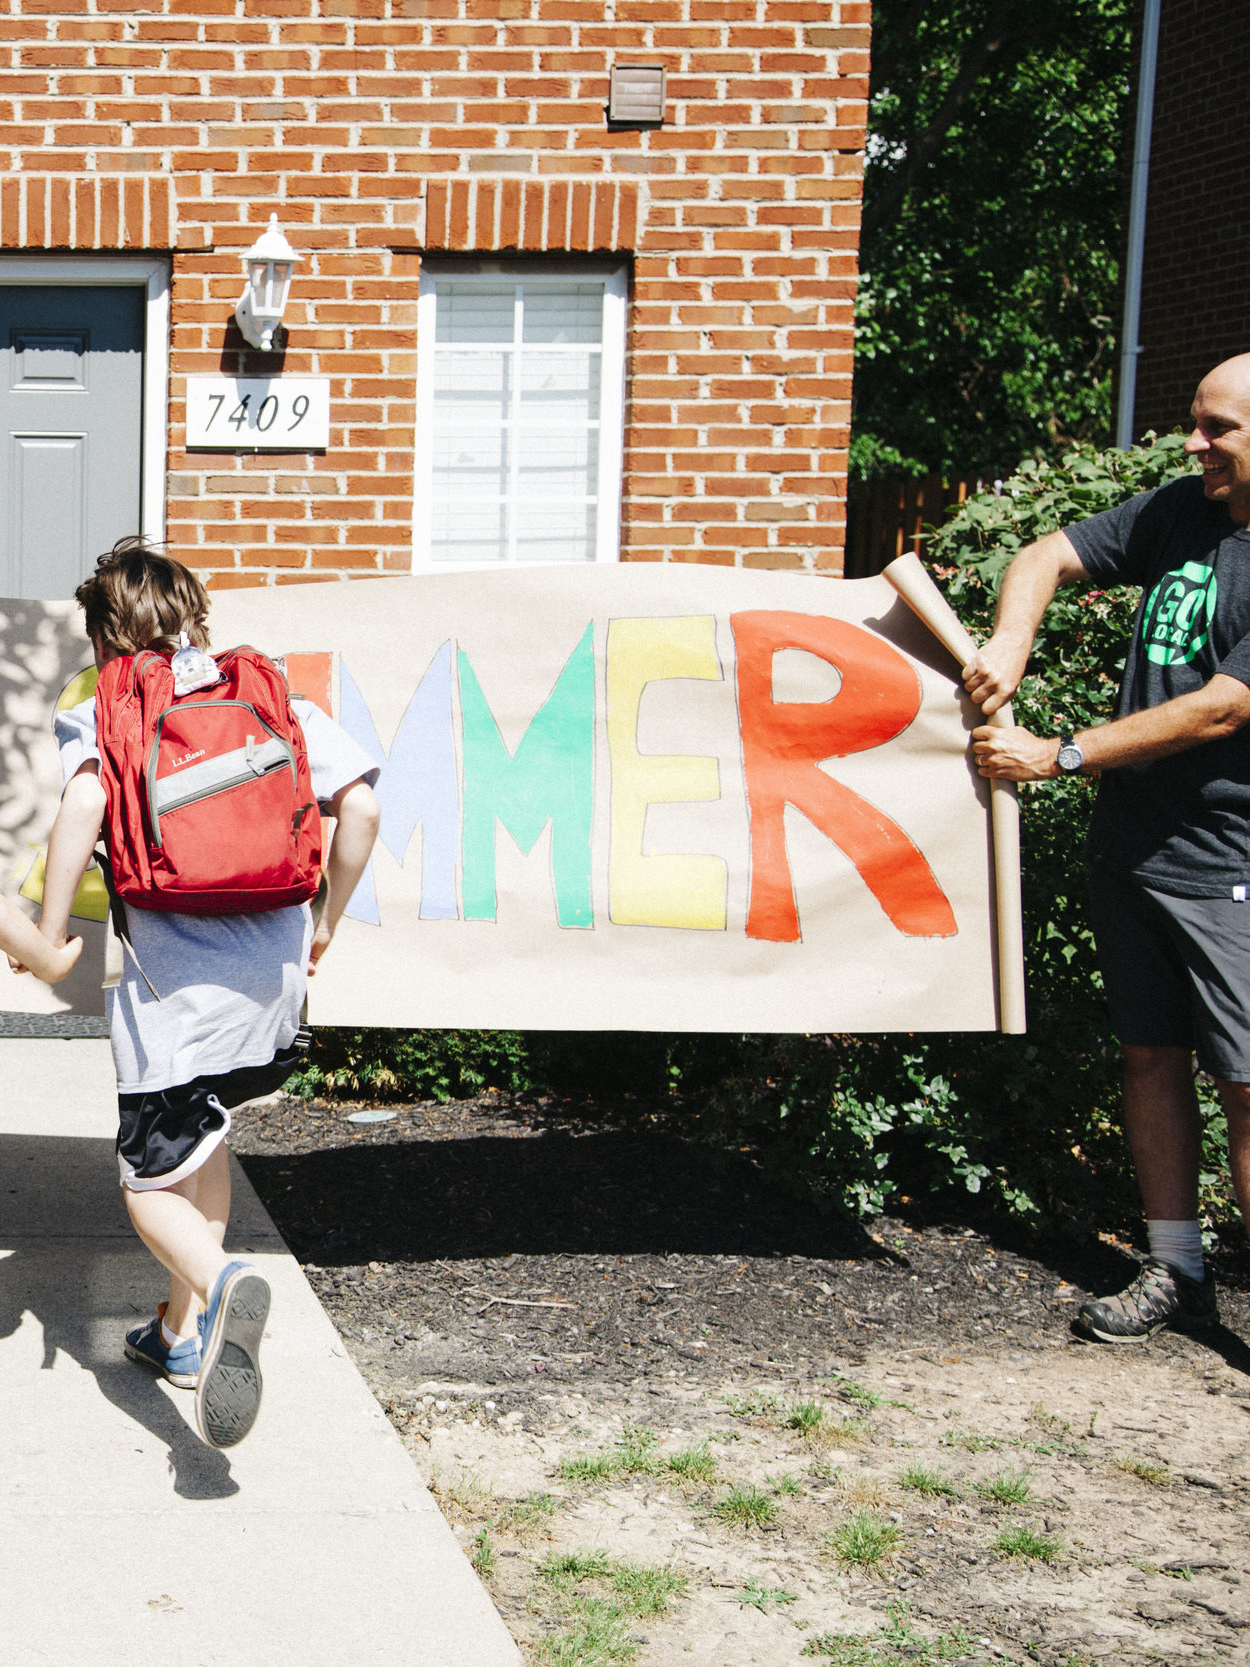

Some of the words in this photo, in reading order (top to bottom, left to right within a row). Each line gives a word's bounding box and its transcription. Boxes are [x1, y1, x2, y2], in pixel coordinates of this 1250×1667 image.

[205, 394, 310, 432] 7409
[1157, 581, 1206, 631] GO
[17, 609, 958, 943] MMER
